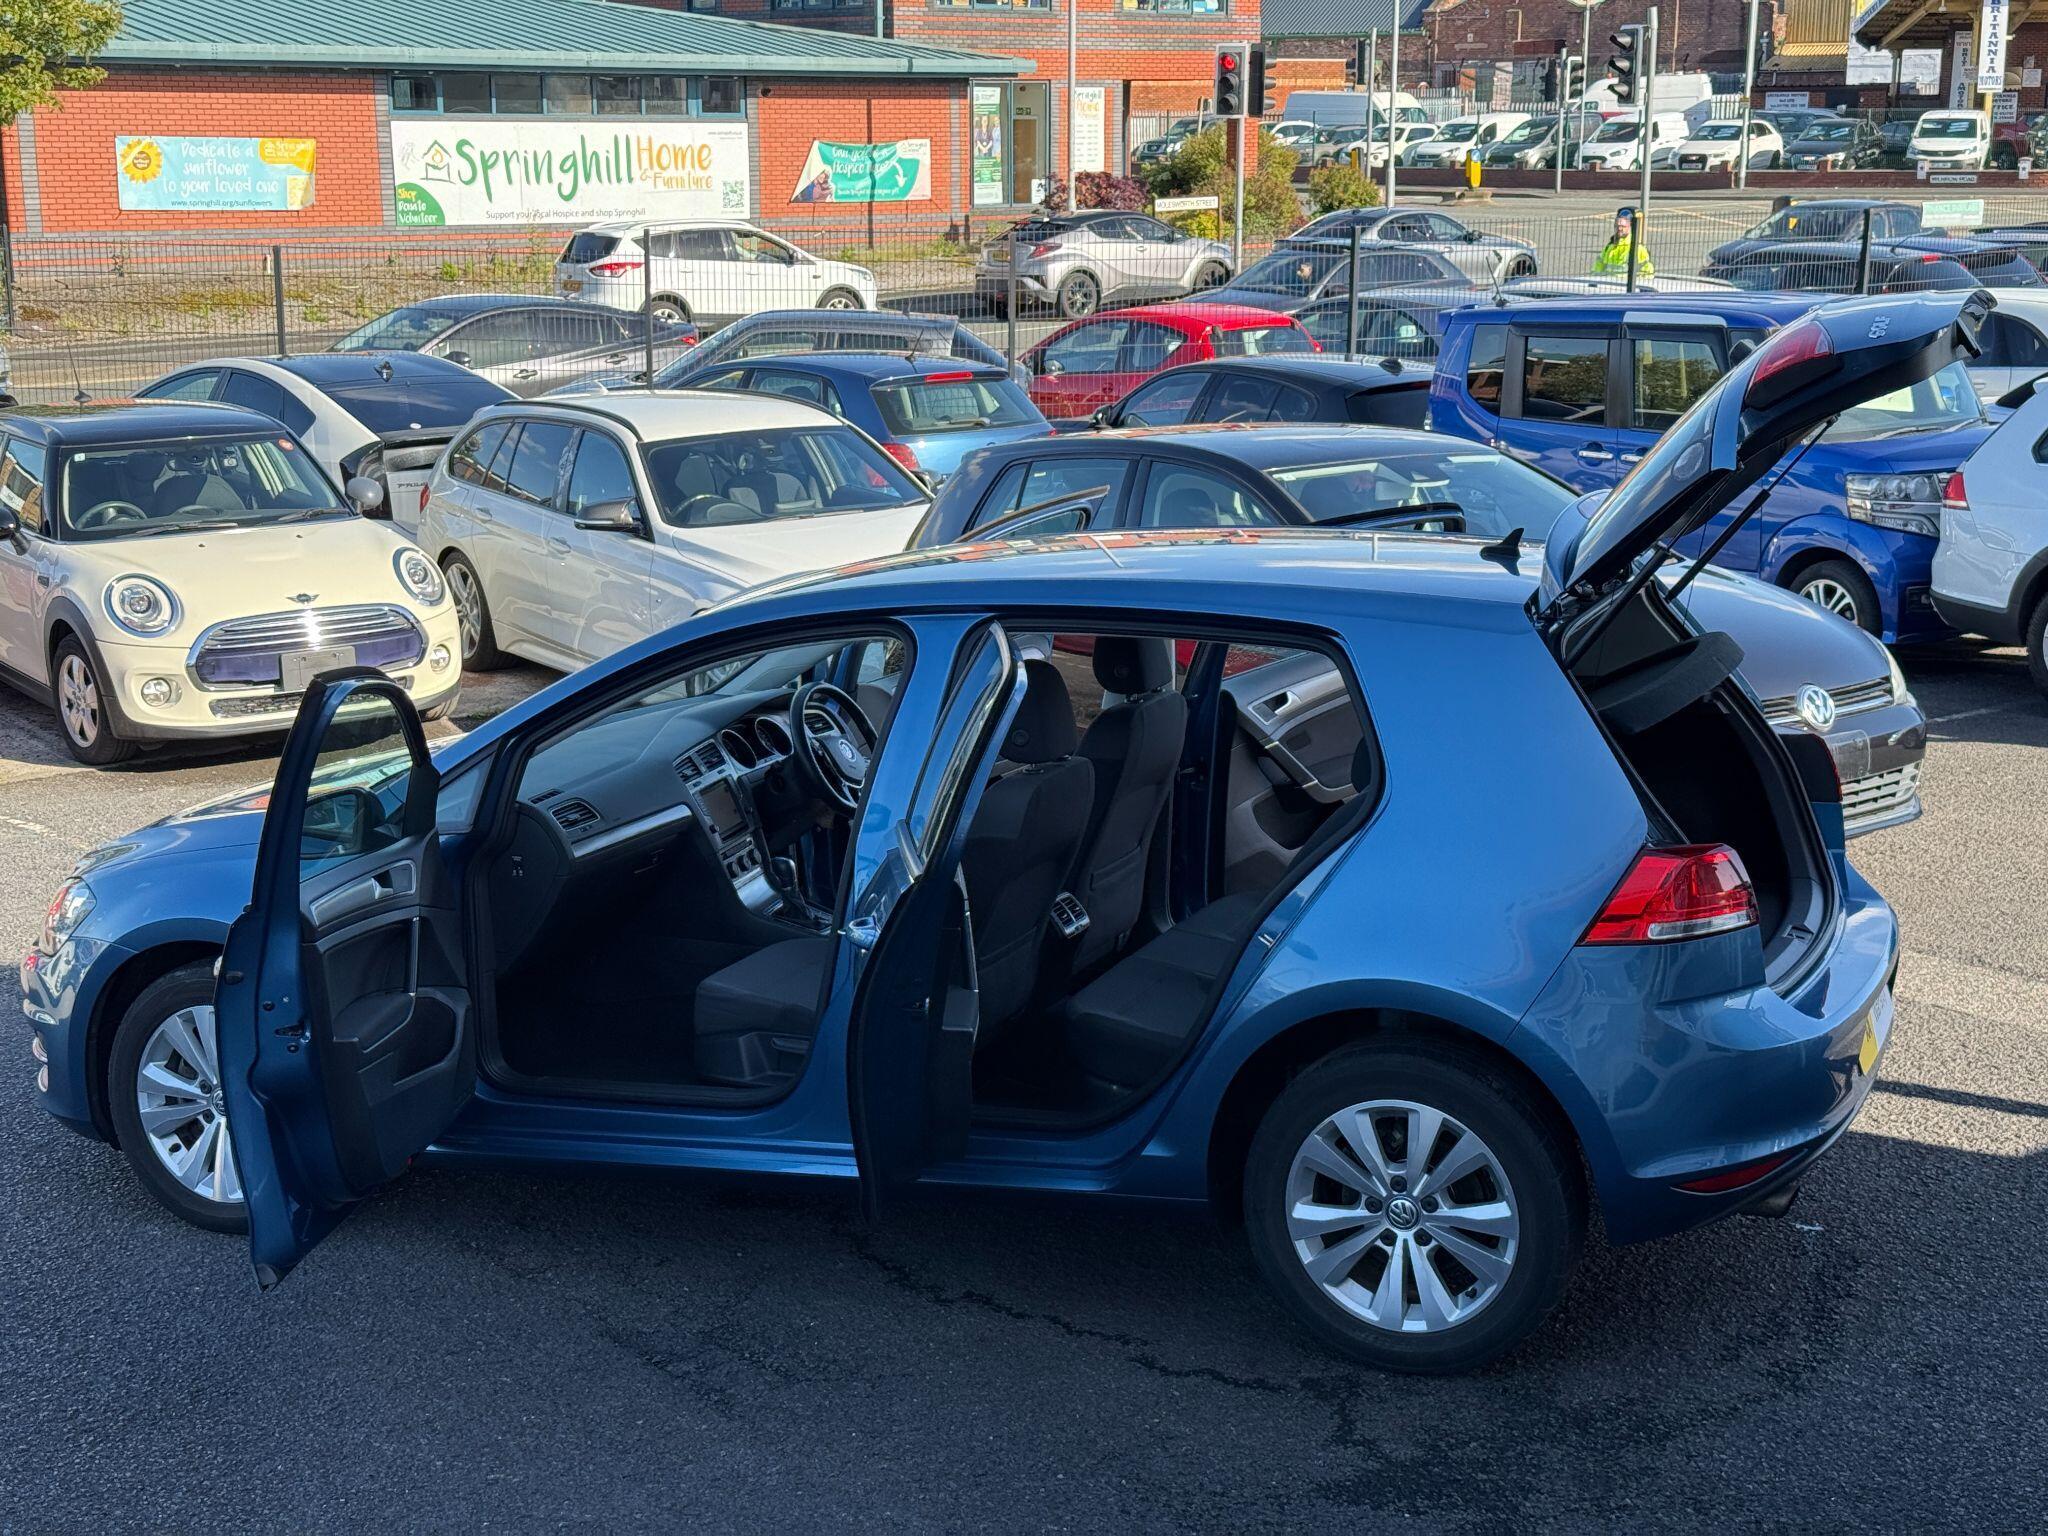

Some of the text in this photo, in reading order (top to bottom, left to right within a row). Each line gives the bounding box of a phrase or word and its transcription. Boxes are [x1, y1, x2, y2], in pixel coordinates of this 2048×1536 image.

[1986, 0, 2001, 73] BRITANNIA
[1978, 75, 2002, 86] MOTORS
[180, 142, 254, 158] Dedicate a
[183, 159, 249, 176] sunflower
[456, 134, 712, 203] Springhill Home
[832, 160, 865, 177] Hospice
[162, 177, 279, 198] to your loved one
[653, 171, 713, 189] Furniture
[398, 188, 416, 202] Shop
[171, 199, 273, 208] www.springhill.org/sunflowers
[399, 200, 427, 212] Donate
[1156, 198, 1216, 209] MOLESWORTH STREET
[399, 212, 438, 224] Volunteer
[486, 210, 515, 220] Support
[516, 211, 532, 220] your
[552, 209, 579, 219] Hospice
[581, 208, 595, 217] and
[596, 208, 614, 218] shop
[615, 207, 646, 217] Springhill
